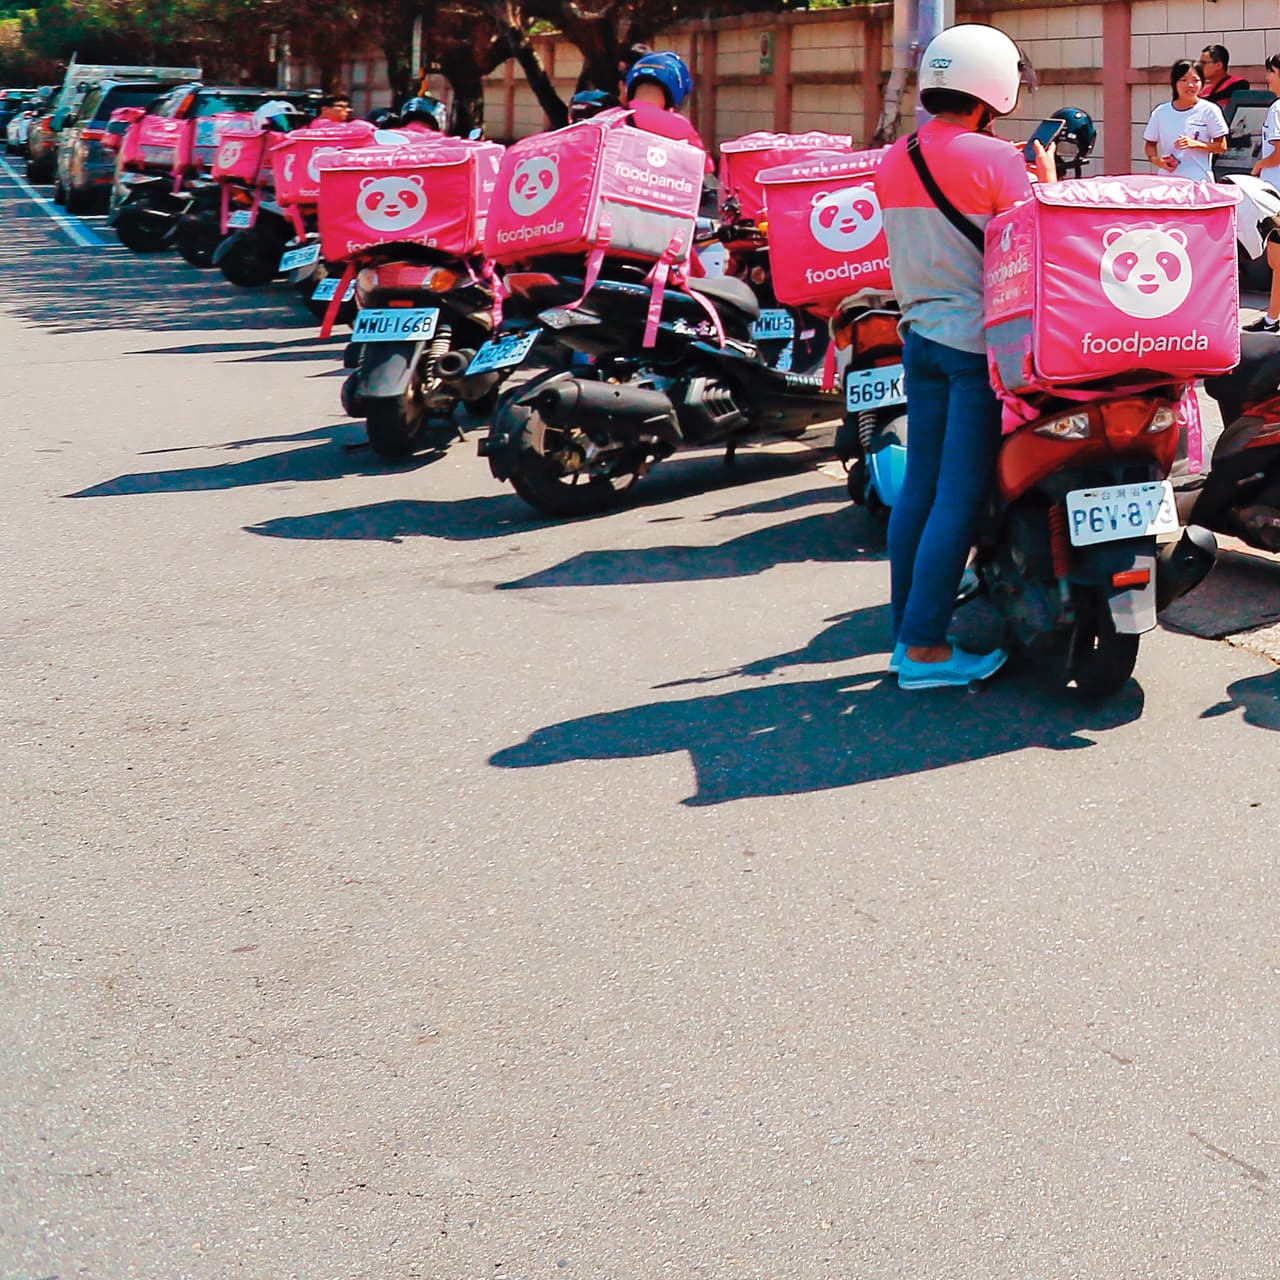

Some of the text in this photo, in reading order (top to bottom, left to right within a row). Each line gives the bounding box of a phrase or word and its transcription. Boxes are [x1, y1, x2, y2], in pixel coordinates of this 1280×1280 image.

[613, 161, 693, 194] foodpanda
[496, 220, 565, 244] foodpanda
[805, 257, 891, 285] foodpan
[356, 315, 433, 334] MWU-1668
[754, 316, 793, 333] MWU-5
[1081, 329, 1209, 357] foodpanda
[850, 377, 902, 405] 569-K
[1071, 499, 1174, 537] P6V-813
